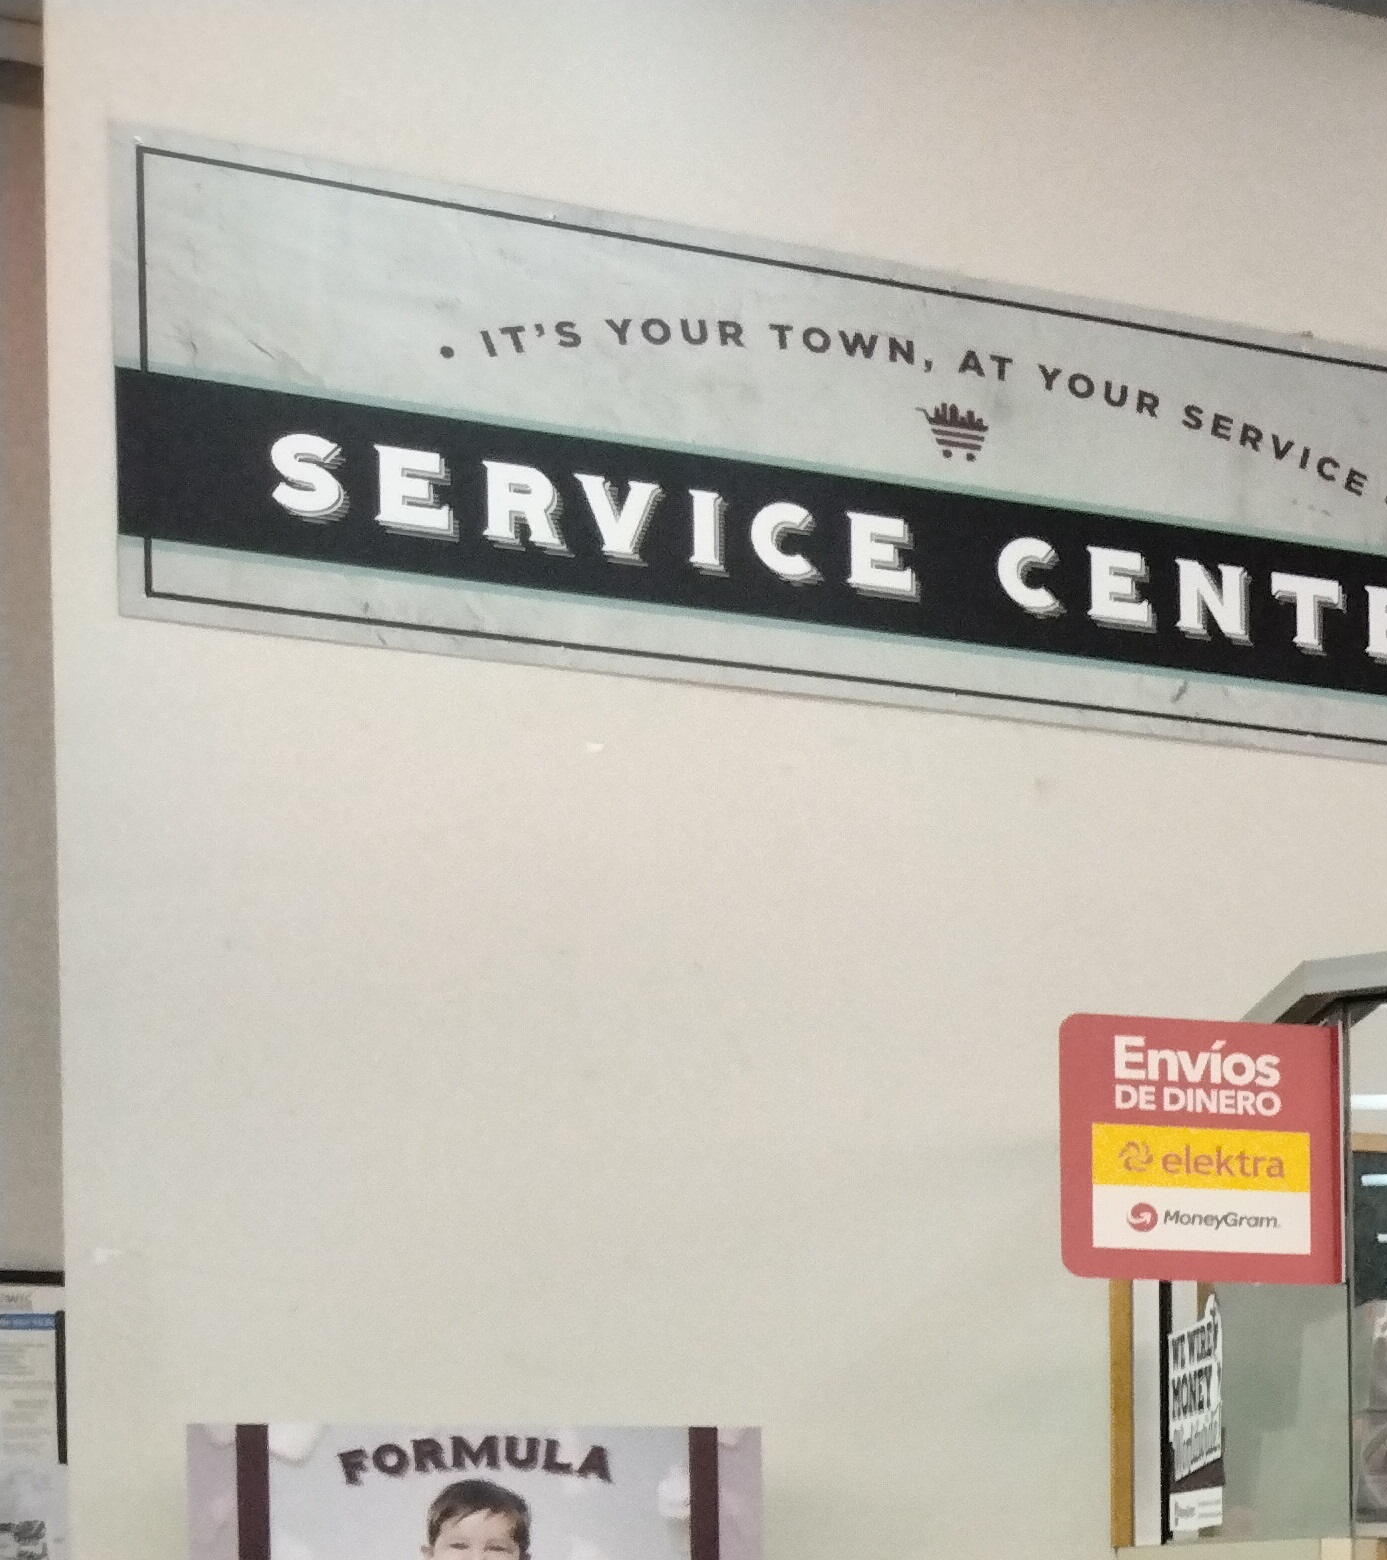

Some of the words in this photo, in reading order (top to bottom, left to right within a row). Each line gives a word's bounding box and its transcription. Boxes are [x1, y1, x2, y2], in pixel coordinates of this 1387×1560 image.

[480, 320, 583, 360] IT'S
[606, 317, 746, 350] YOUR
[771, 325, 934, 375] TOWN,
[957, 349, 1013, 379] AT
[1039, 364, 1160, 420] YOUR
[1180, 405, 1371, 496] SERVICE
[270, 430, 920, 596] SERVICE
[1114, 1035, 1281, 1088] Envíos
[1115, 1084, 1155, 1110] DE
[1163, 1087, 1282, 1117] DINERO
[1161, 1145, 1284, 1178] elektra
[1164, 1209, 1279, 1230] MoneyGram
[338, 1434, 613, 1485] FORMULA
